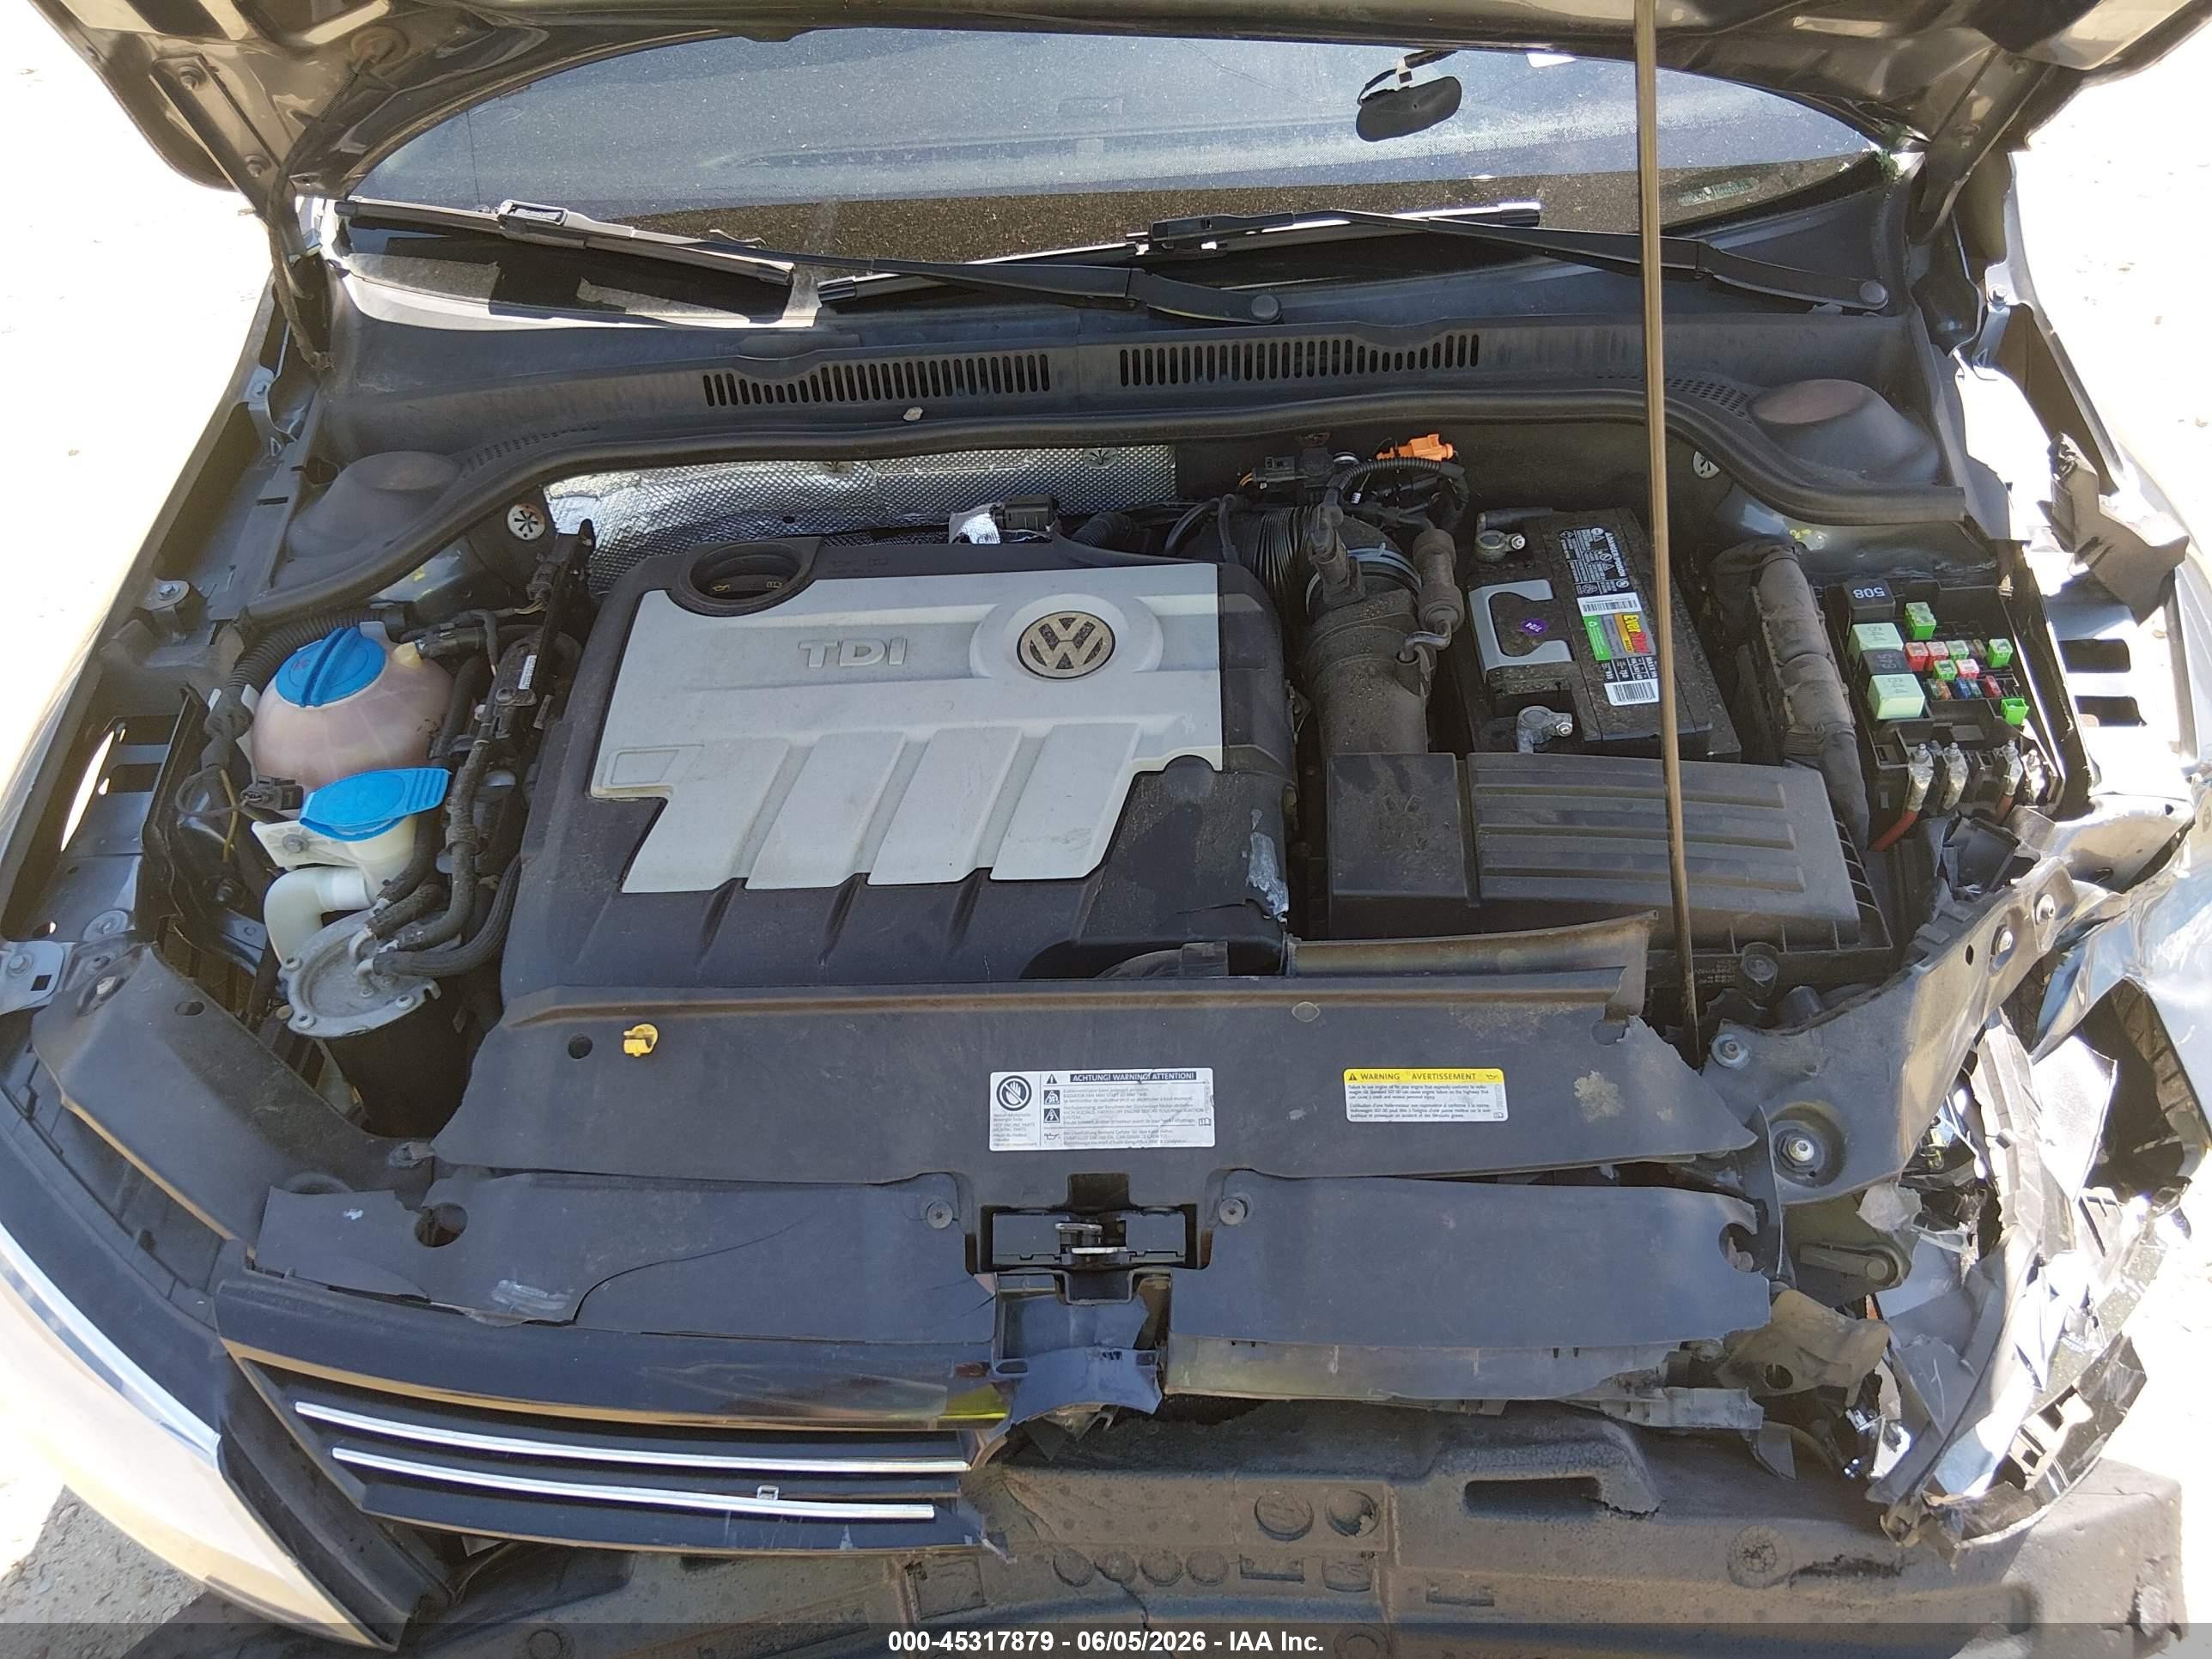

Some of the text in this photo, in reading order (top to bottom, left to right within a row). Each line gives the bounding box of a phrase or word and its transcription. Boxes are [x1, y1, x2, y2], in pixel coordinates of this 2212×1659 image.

[1853, 587, 1886, 599] 508
[798, 637, 908, 669] TDI
[1152, 1072, 1194, 1080] ATTENTION!
